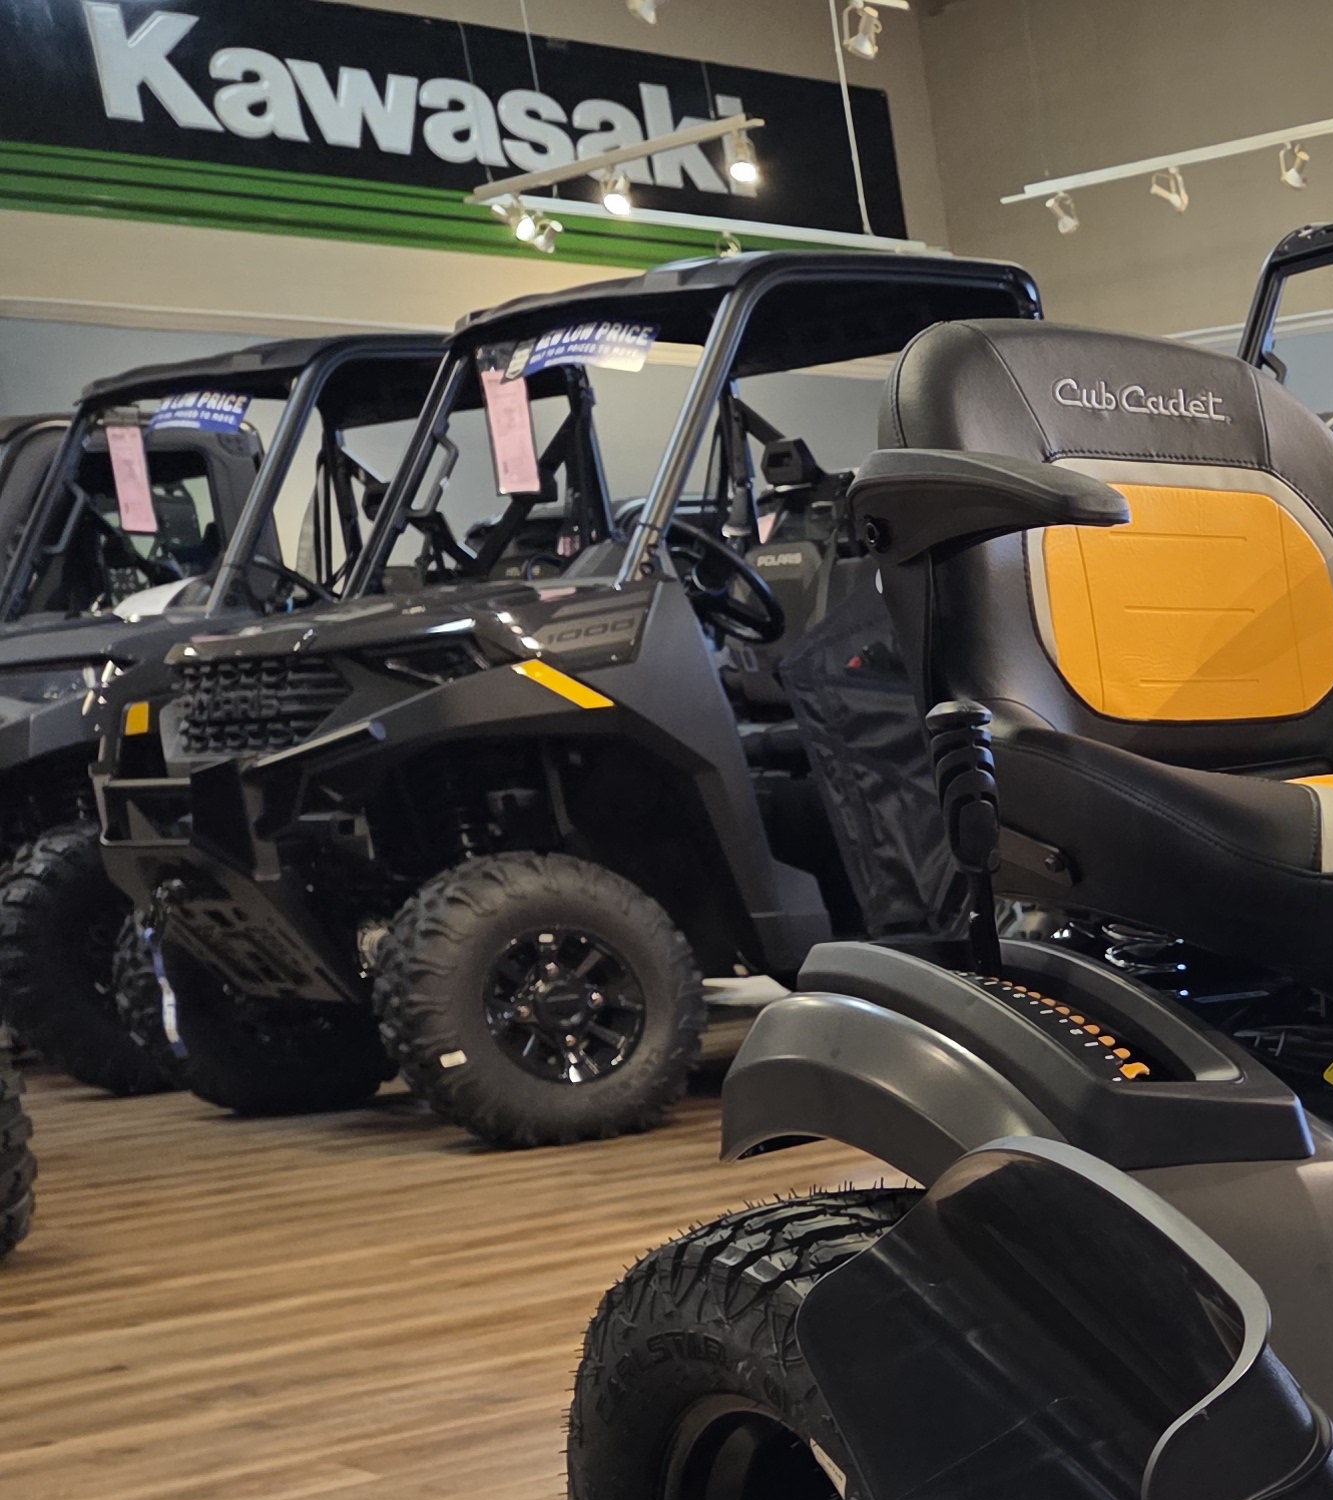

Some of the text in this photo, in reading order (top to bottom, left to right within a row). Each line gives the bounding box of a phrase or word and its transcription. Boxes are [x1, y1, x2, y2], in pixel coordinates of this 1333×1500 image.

[80, 0, 758, 197] Kawasaki
[595, 321, 654, 346] PRICE
[197, 391, 247, 414] PRICE
[1054, 378, 1226, 421] Cub Cadet
[757, 552, 803, 567] POLARIS
[545, 617, 636, 645] 1000
